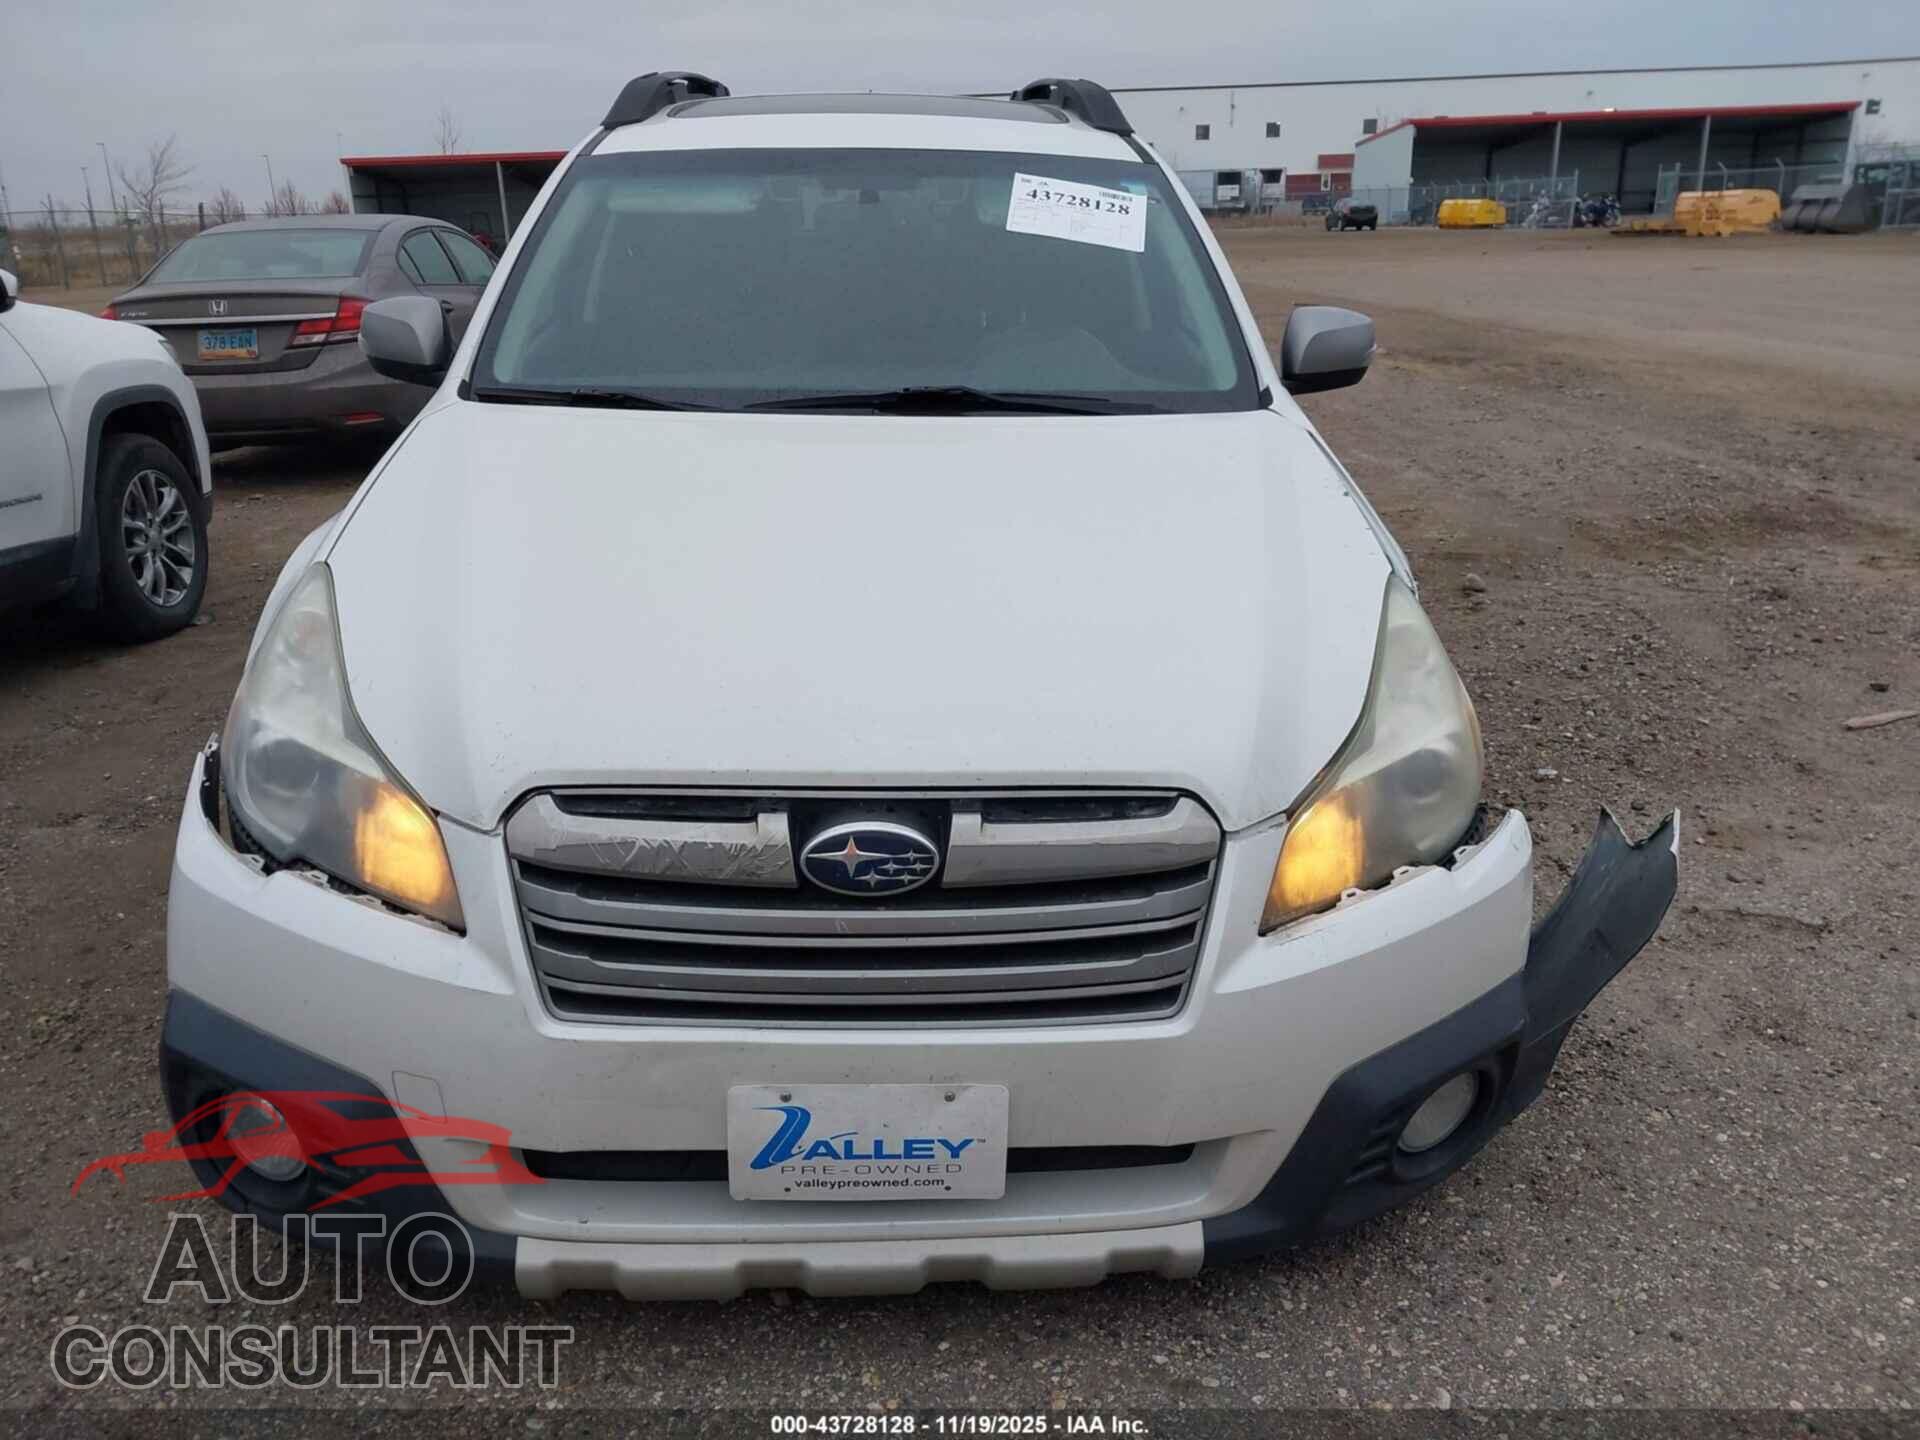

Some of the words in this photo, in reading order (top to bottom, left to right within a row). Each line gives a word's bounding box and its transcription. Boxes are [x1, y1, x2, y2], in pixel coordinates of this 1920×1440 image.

[1026, 188, 1131, 216] 43728128
[781, 1163, 962, 1175] PRE-OWNED
[795, 1178, 945, 1190] valleypreowned.com
